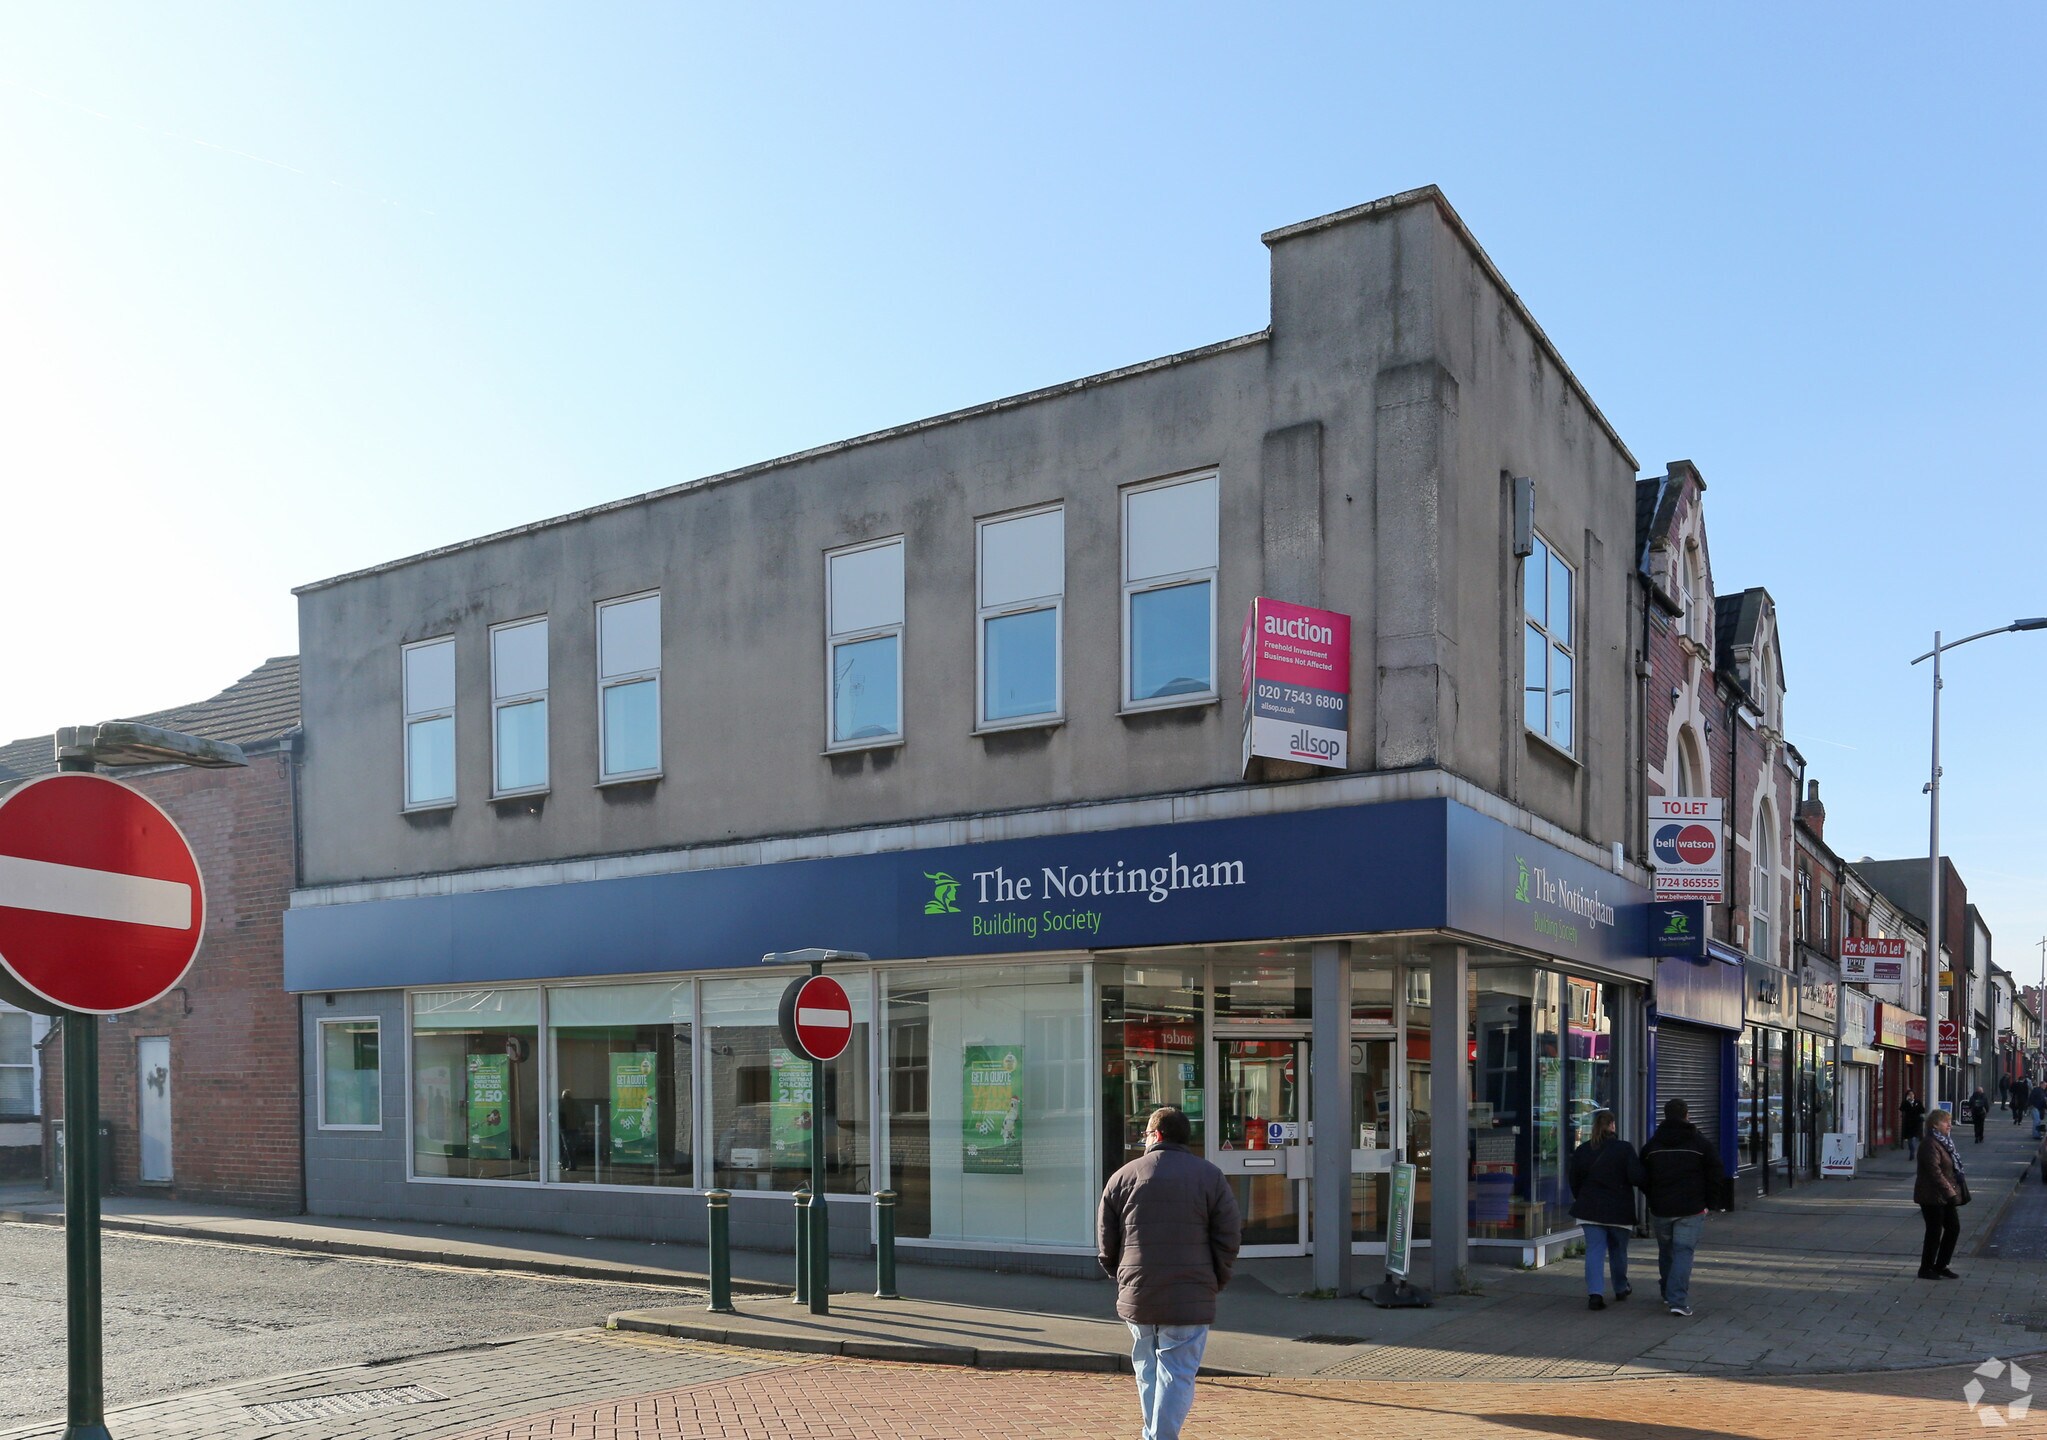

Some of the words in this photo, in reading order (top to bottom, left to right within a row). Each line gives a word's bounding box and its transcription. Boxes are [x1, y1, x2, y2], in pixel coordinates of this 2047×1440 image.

[1264, 616, 1332, 645] auction
[1264, 640, 1293, 652] Freehold
[1294, 645, 1328, 659] Investment
[1264, 652, 1294, 664] Business
[1294, 657, 1306, 666] Not
[1307, 659, 1333, 672] Affected
[1258, 684, 1281, 700] 020
[1284, 688, 1312, 705] 7543
[1316, 694, 1344, 712] 6800
[1261, 702, 1296, 714] allsop.co.uk
[1290, 729, 1340, 761] allsop
[1662, 802, 1681, 815] TO
[1684, 802, 1708, 815] LET
[1656, 838, 1674, 848] bell
[1678, 840, 1714, 849] watson
[972, 866, 1032, 904] The
[1042, 852, 1246, 904] Nottingham
[1656, 878, 1680, 888] 1724
[1682, 878, 1720, 888] 865555
[1533, 866, 1556, 904] The
[1558, 878, 1615, 929] Nottingham
[972, 912, 1038, 938] Building
[1043, 910, 1102, 934] Society
[1534, 911, 1558, 943] Building
[1558, 918, 1578, 948] Society
[1844, 940, 1858, 953] For
[1860, 940, 1888, 955] Sale/To
[1890, 942, 1902, 955] Let
[631, 1075, 648, 1084] QUOTE
[972, 1072, 983, 1082] GET
[984, 1072, 989, 1082] A
[990, 1072, 1012, 1082] QUOTE
[474, 1090, 502, 1102] 2.50
[779, 1089, 812, 1103] 2.50
[1822, 1155, 1852, 1166] Nails
